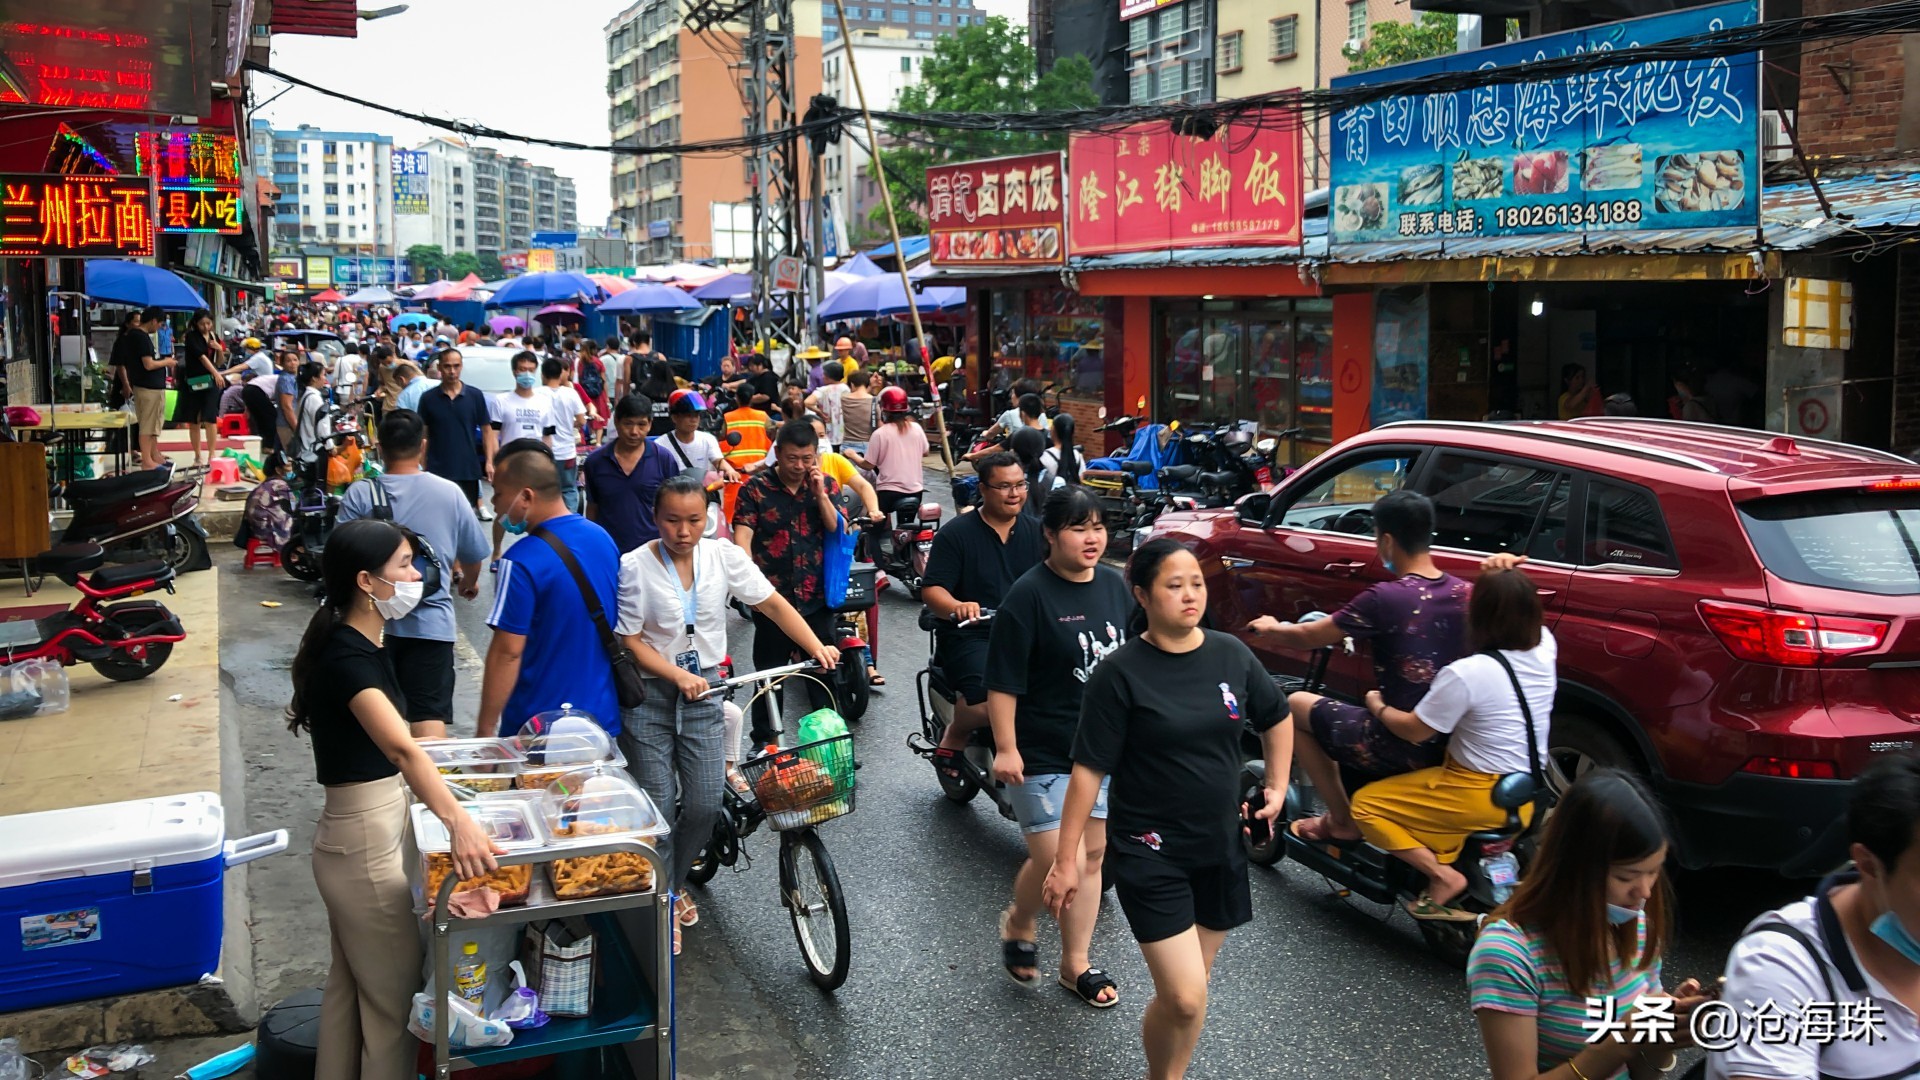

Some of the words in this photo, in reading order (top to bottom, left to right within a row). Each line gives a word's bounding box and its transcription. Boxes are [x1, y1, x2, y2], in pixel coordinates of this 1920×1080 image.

[157, 191, 238, 228] 县小吃
[1079, 149, 1286, 223] 隆江猪脚饭
[2, 184, 147, 249] 兰州拉面
[1399, 208, 1483, 236] 联系电话：
[1496, 200, 1642, 228] 18026134188
